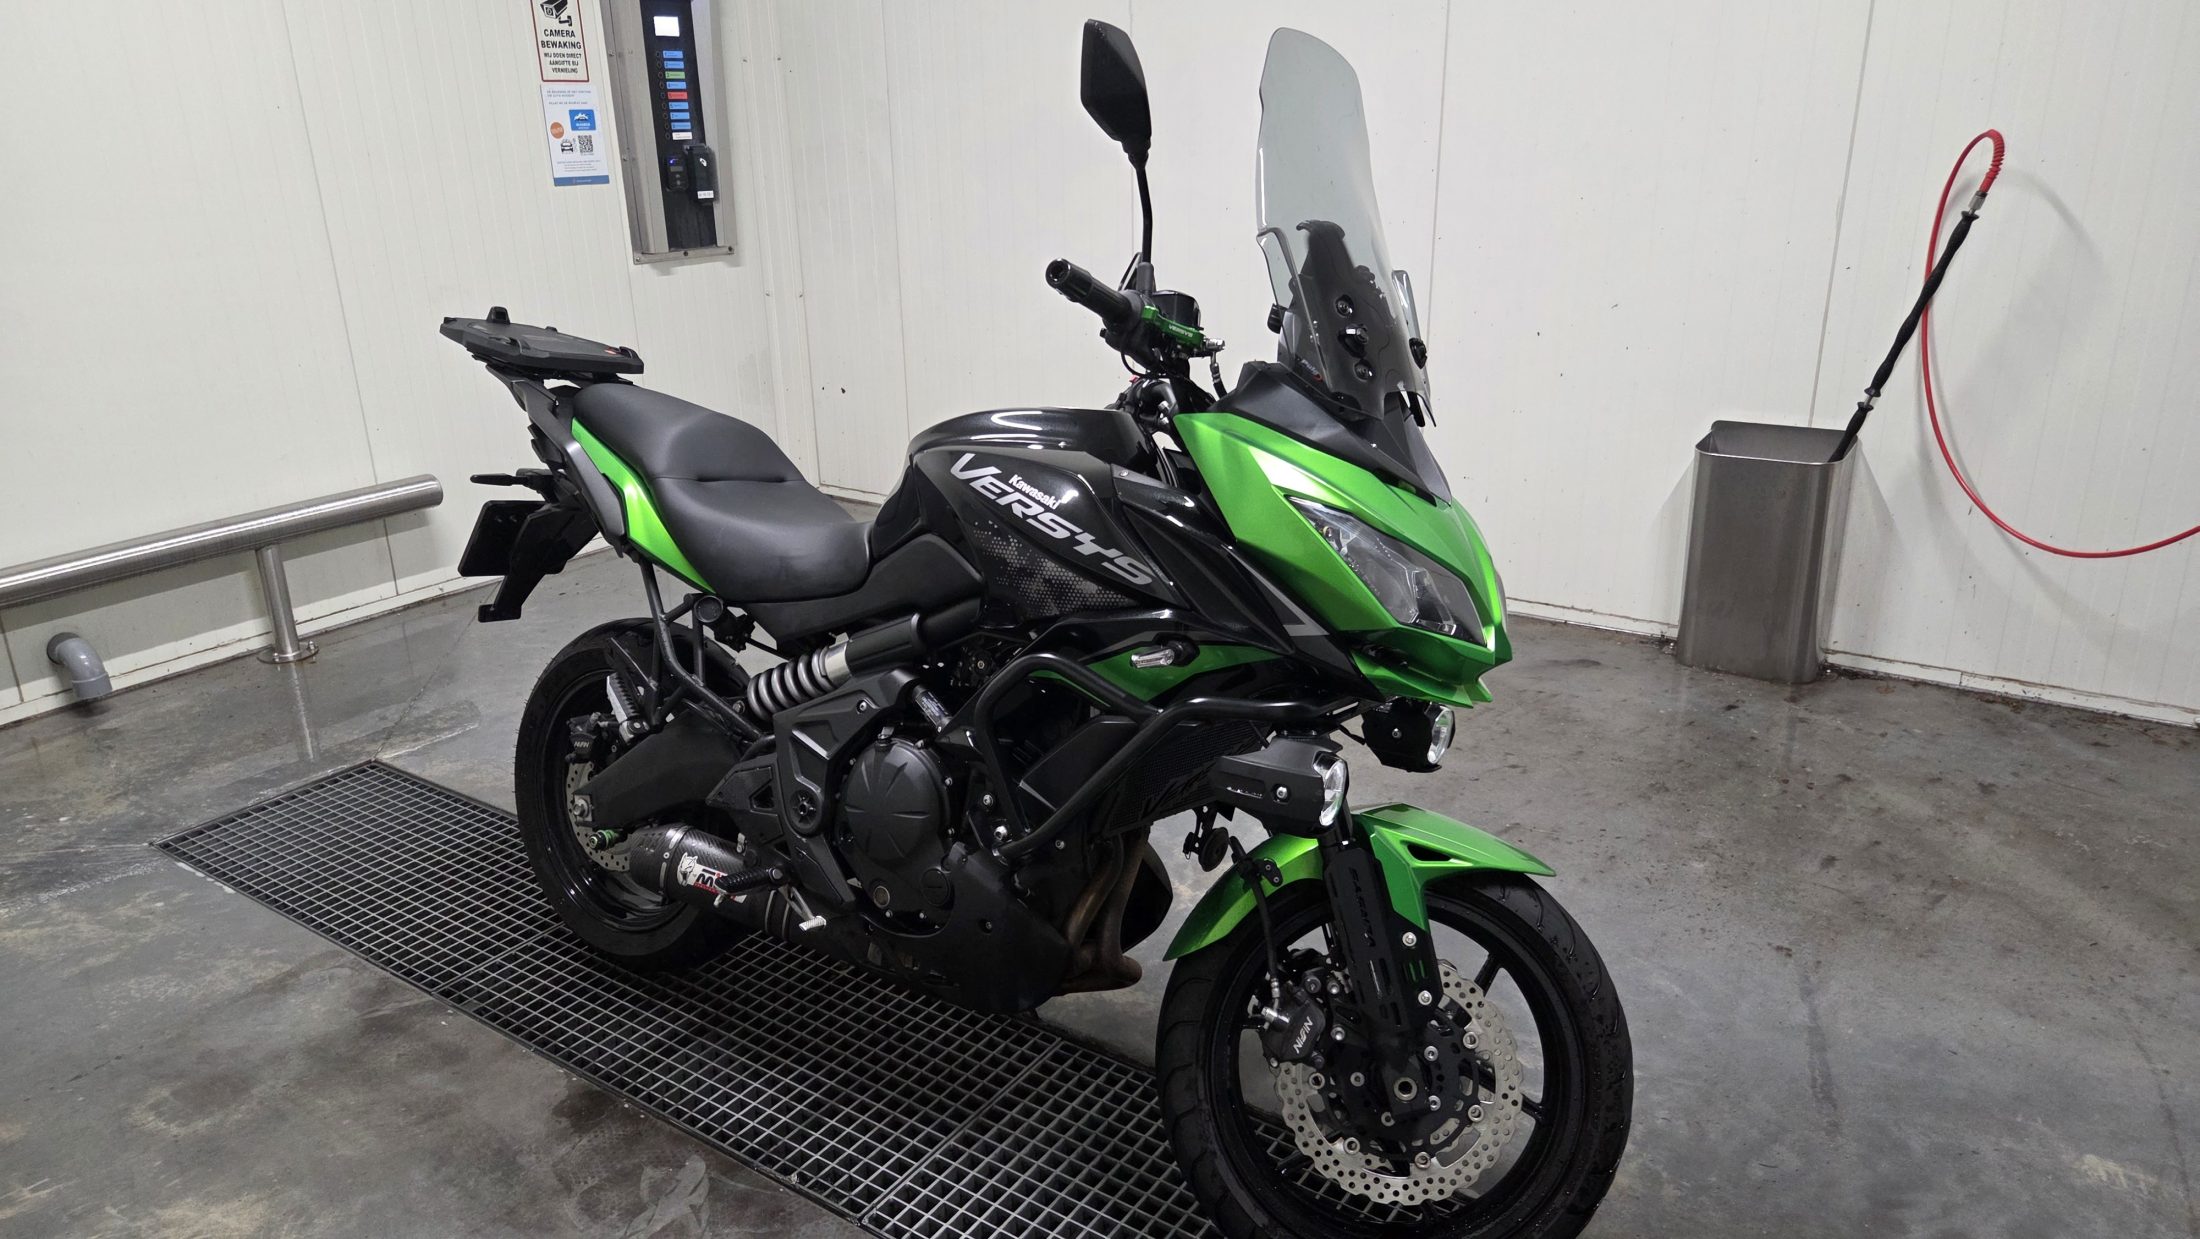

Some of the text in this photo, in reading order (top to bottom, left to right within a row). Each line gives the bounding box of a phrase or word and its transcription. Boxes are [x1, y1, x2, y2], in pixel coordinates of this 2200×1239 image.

[541, 40, 582, 49] BEWAKING
[544, 29, 576, 38] CAMERA
[1008, 474, 1061, 510] Kawasaki
[950, 453, 1158, 585] VERSYS
